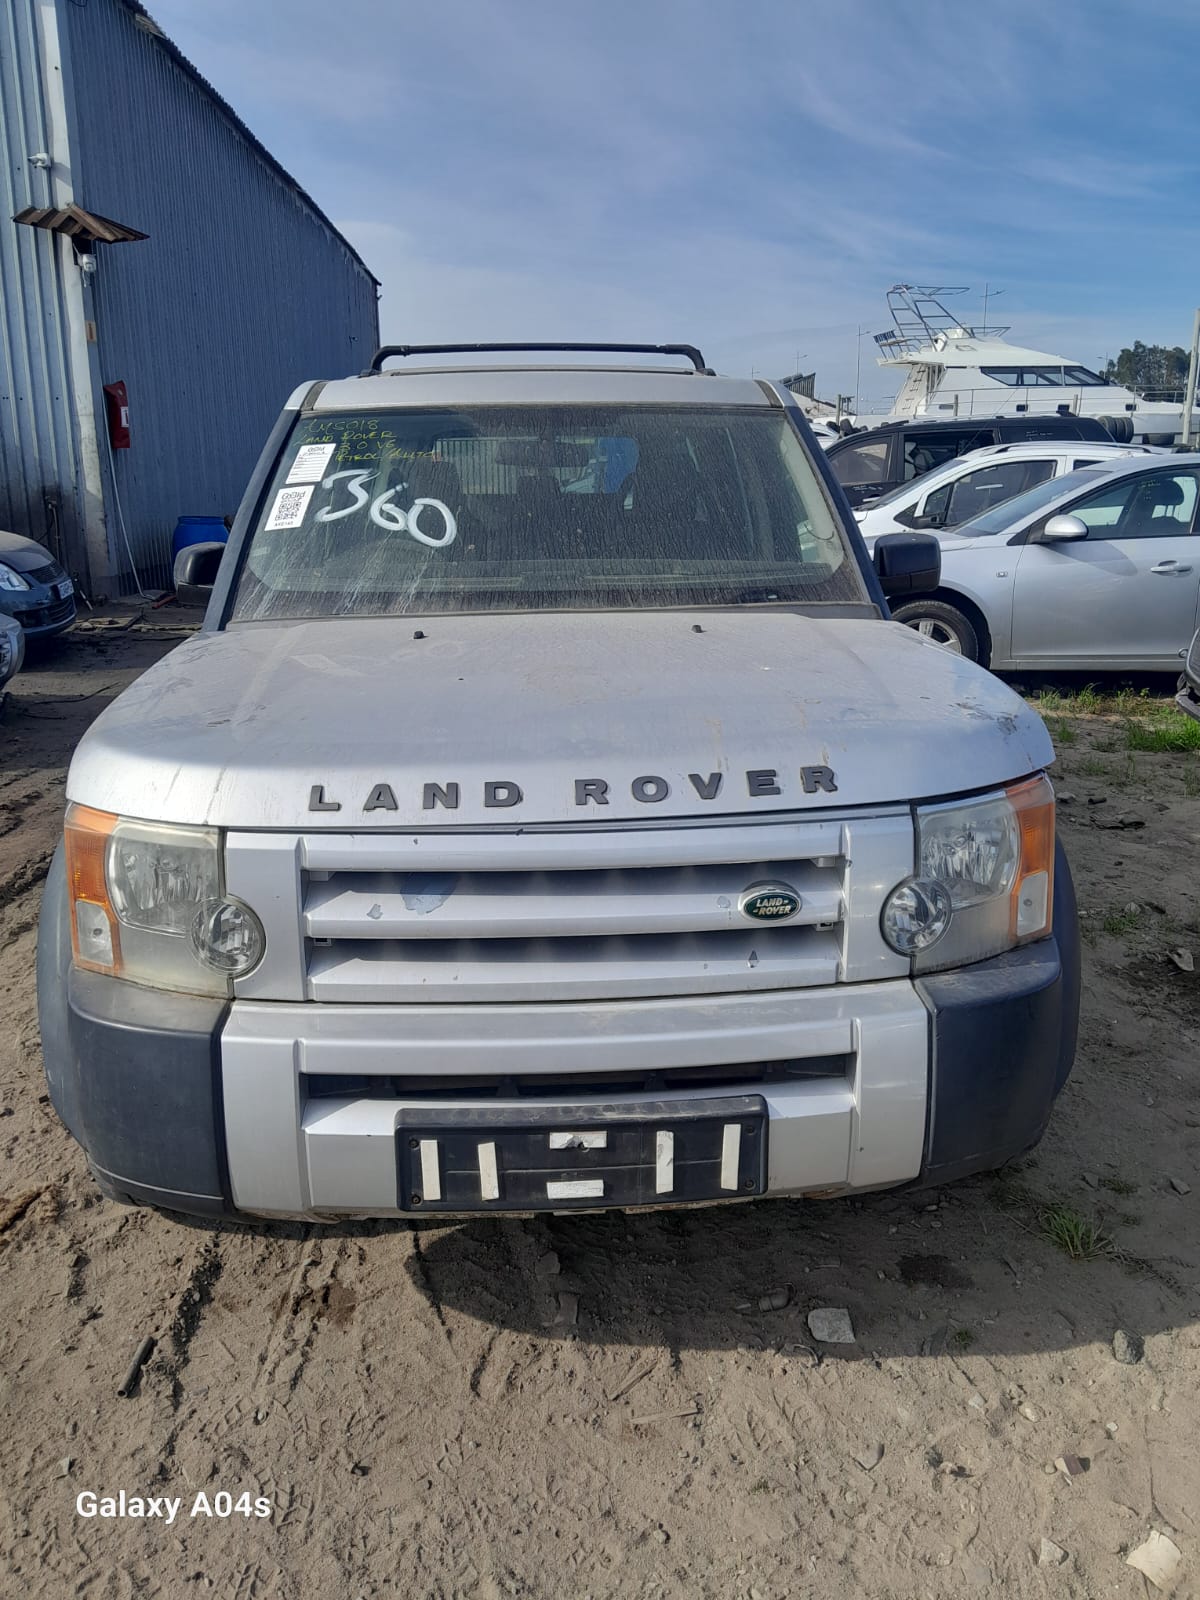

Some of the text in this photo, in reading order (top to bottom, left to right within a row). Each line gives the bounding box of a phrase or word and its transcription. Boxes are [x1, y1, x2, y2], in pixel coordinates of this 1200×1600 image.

[314, 468, 457, 547] 360
[308, 765, 838, 812] LAND ROVER
[756, 897, 784, 907] LAND
[758, 905, 791, 915] ROVER
